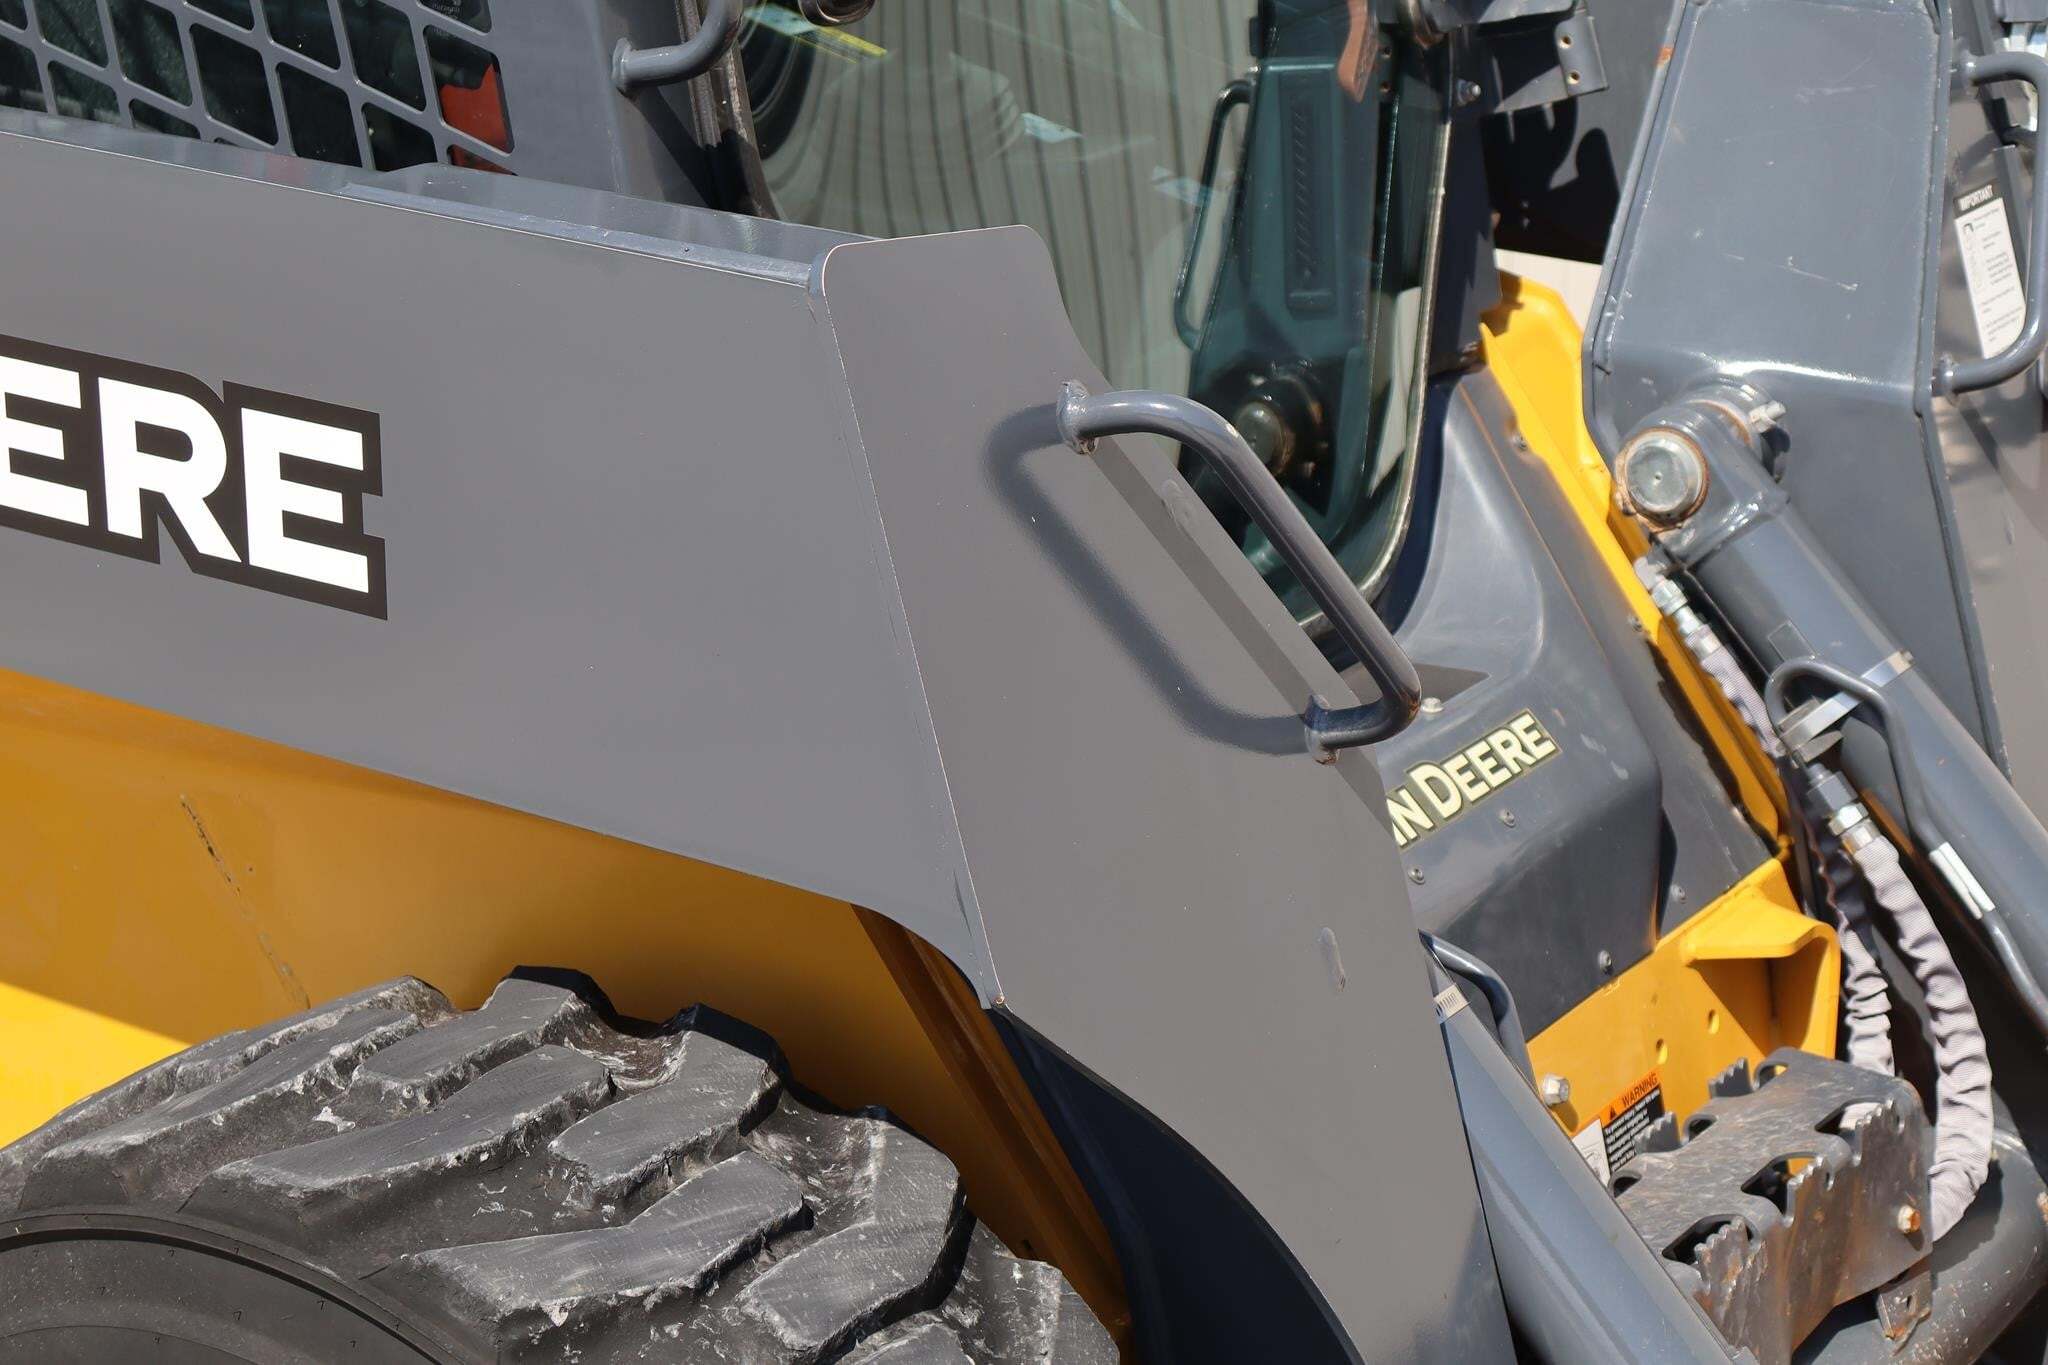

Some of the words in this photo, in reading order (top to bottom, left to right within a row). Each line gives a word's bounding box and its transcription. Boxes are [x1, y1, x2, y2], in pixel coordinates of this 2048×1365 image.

[1959, 185, 1994, 212] IMPORTANT
[0, 356, 369, 594] ERE
[1410, 713, 1556, 818] DEERE
[1622, 1072, 1658, 1107] WARNING
